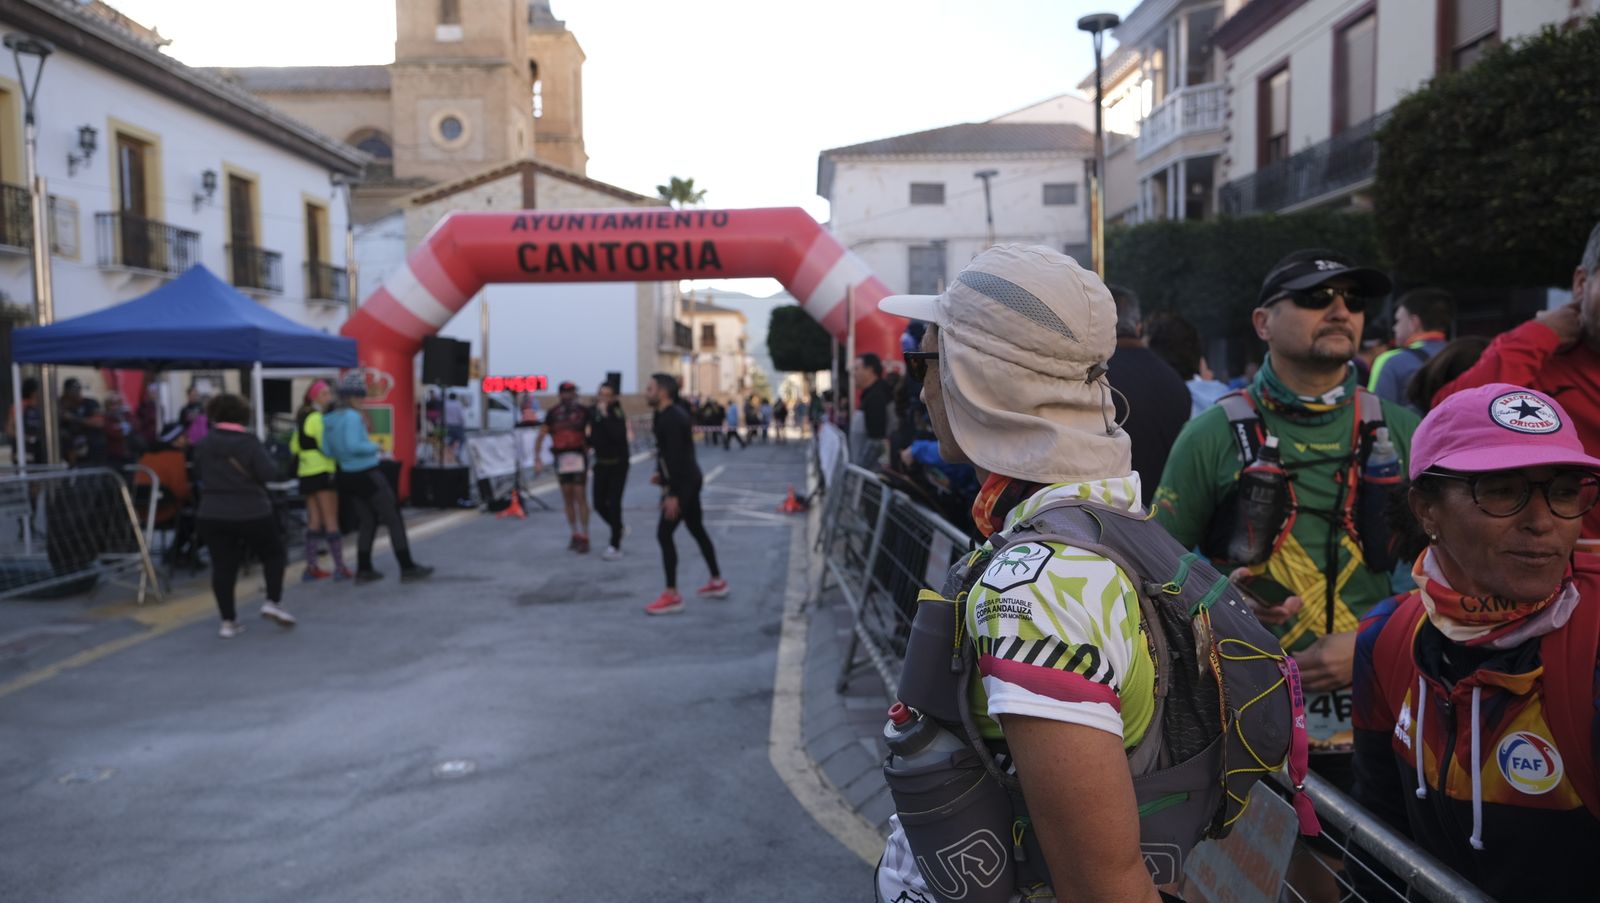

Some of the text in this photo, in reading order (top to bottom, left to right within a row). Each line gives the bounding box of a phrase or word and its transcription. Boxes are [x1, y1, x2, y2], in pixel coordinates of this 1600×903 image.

[512, 211, 729, 232] AYUNTAMIENTO
[517, 239, 722, 273] CANTORIA
[976, 598, 1032, 611] PRUEBA PUNTUABLE
[976, 605, 1032, 619] COPA ANDALUZA
[1460, 596, 1518, 613] CXM
[1512, 757, 1543, 771] FAF
